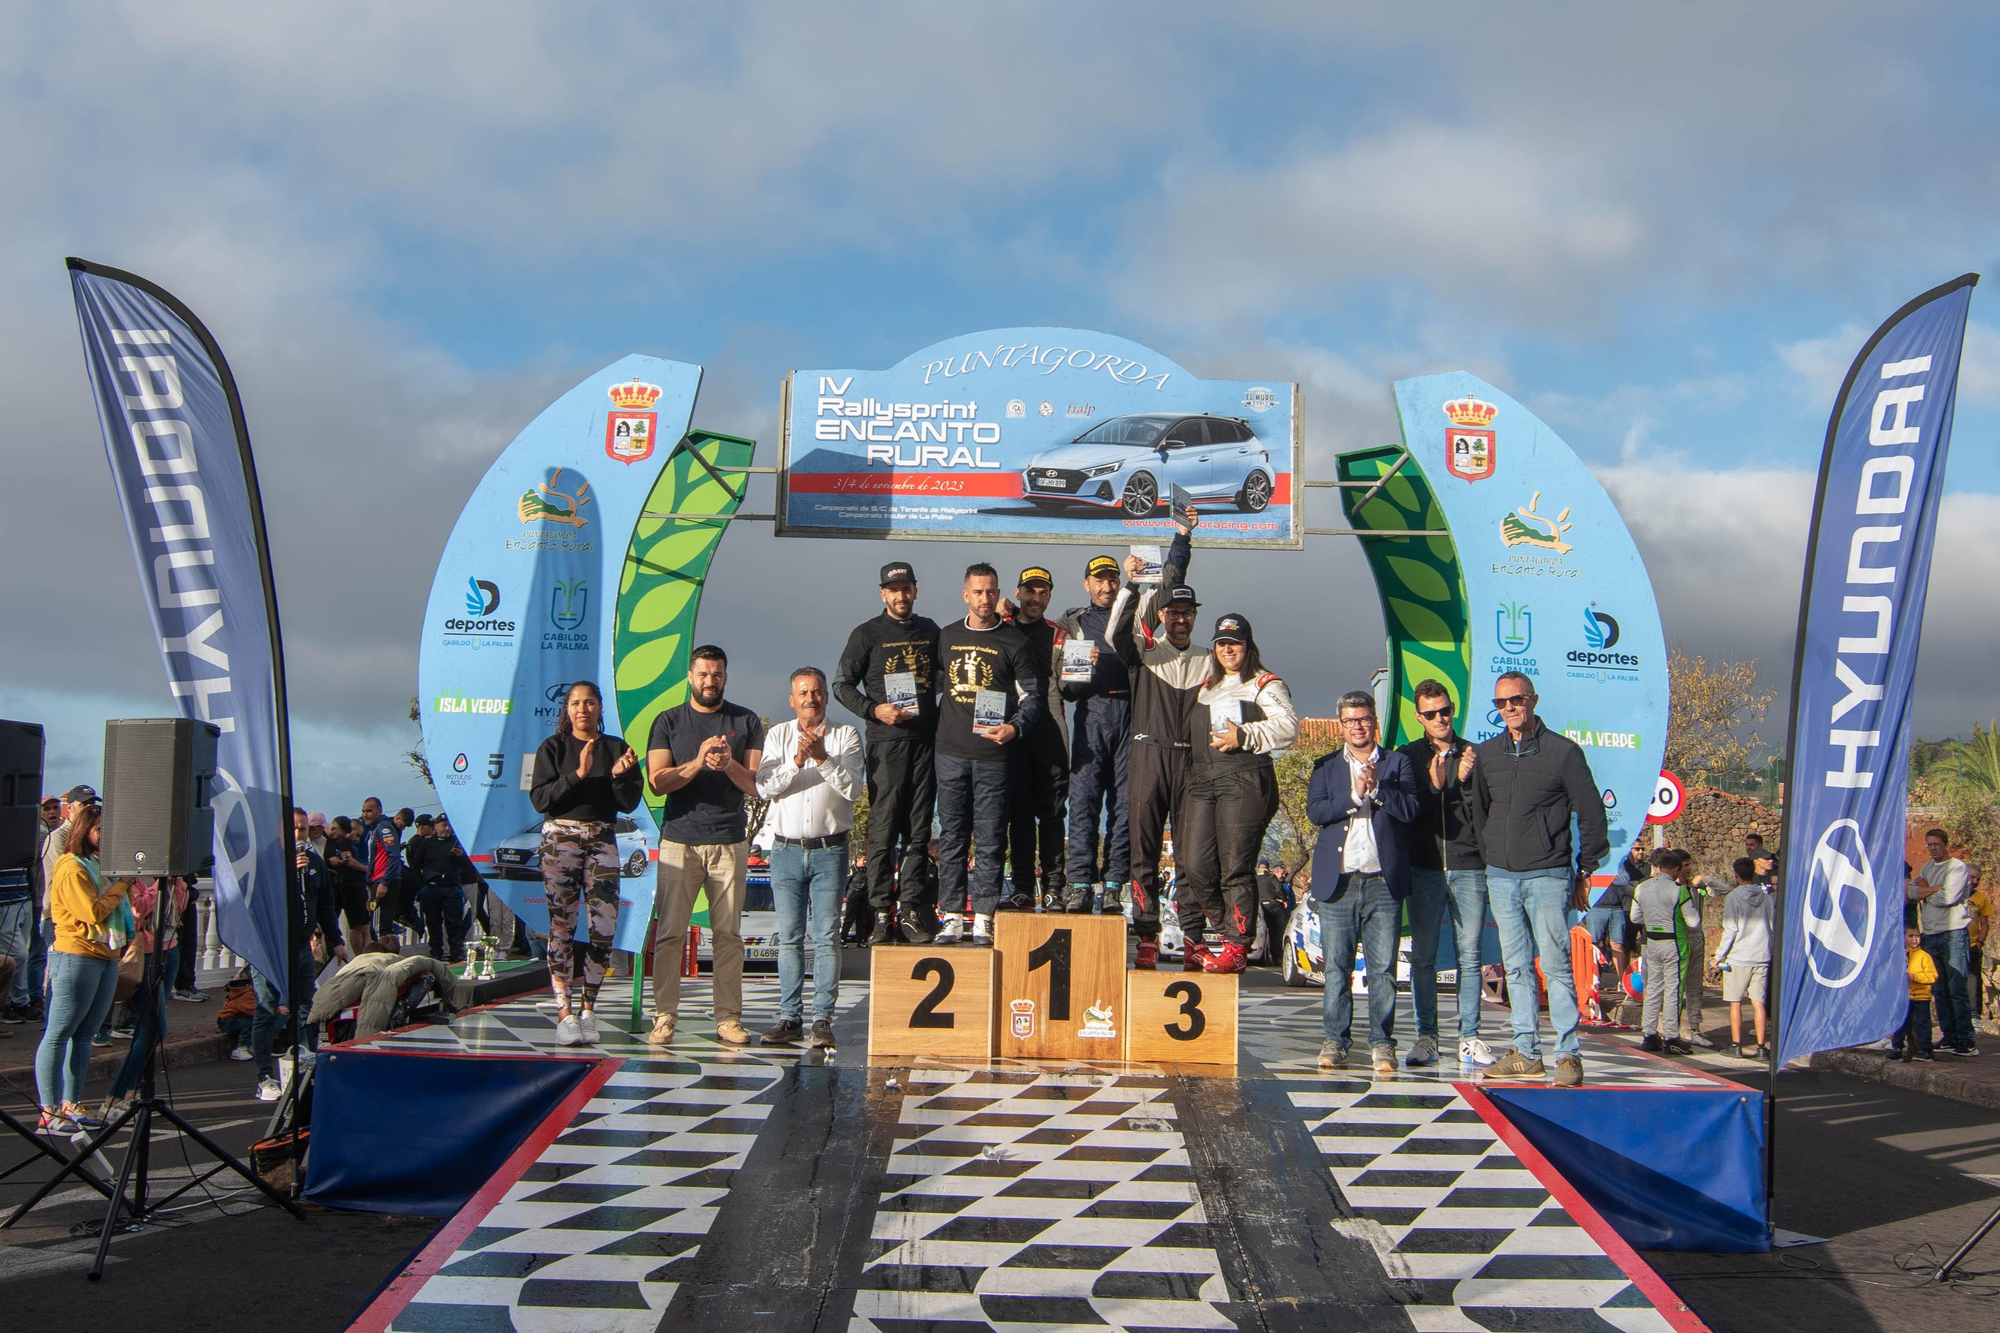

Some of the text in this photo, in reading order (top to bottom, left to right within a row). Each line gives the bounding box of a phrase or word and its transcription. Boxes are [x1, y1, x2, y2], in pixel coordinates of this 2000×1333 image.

[922, 343, 1171, 390] PUNTAGORDA
[819, 376, 854, 395] IV
[817, 398, 978, 422] Rallysprint
[1067, 402, 1096, 416] fialp
[815, 419, 1001, 444] ENCANTO
[867, 445, 1001, 468] RURAL
[859, 475, 871, 490] de
[872, 475, 915, 490] noviembre
[917, 476, 929, 490] de
[930, 479, 965, 491] 2023
[815, 504, 858, 512] Campeonato
[839, 512, 882, 520] Campeonato
[523, 531, 578, 540] PUNTAGORDA
[505, 539, 595, 551] Encanto Rural
[1508, 555, 1564, 566] PUNTAGORDA
[1492, 563, 1582, 579] Encanto Rural
[1826, 354, 1932, 789] HYUNDAI
[445, 618, 515, 633] deportes
[544, 633, 588, 642] CABILDO
[541, 641, 589, 651] LA PALMA
[1492, 656, 1537, 667] CABILDO
[1567, 650, 1639, 666] deportes
[1490, 665, 1504, 674] LA
[1567, 671, 1596, 679] CABILDO
[1617, 674, 1639, 682] PALMA
[440, 698, 511, 715] ISLA VERDE
[1566, 719, 1591, 730] AUTOS
[1596, 731, 1636, 748] VERDE
[1028, 929, 1072, 1021] 1
[909, 957, 955, 1029] 2
[1164, 980, 1206, 1041] 3
